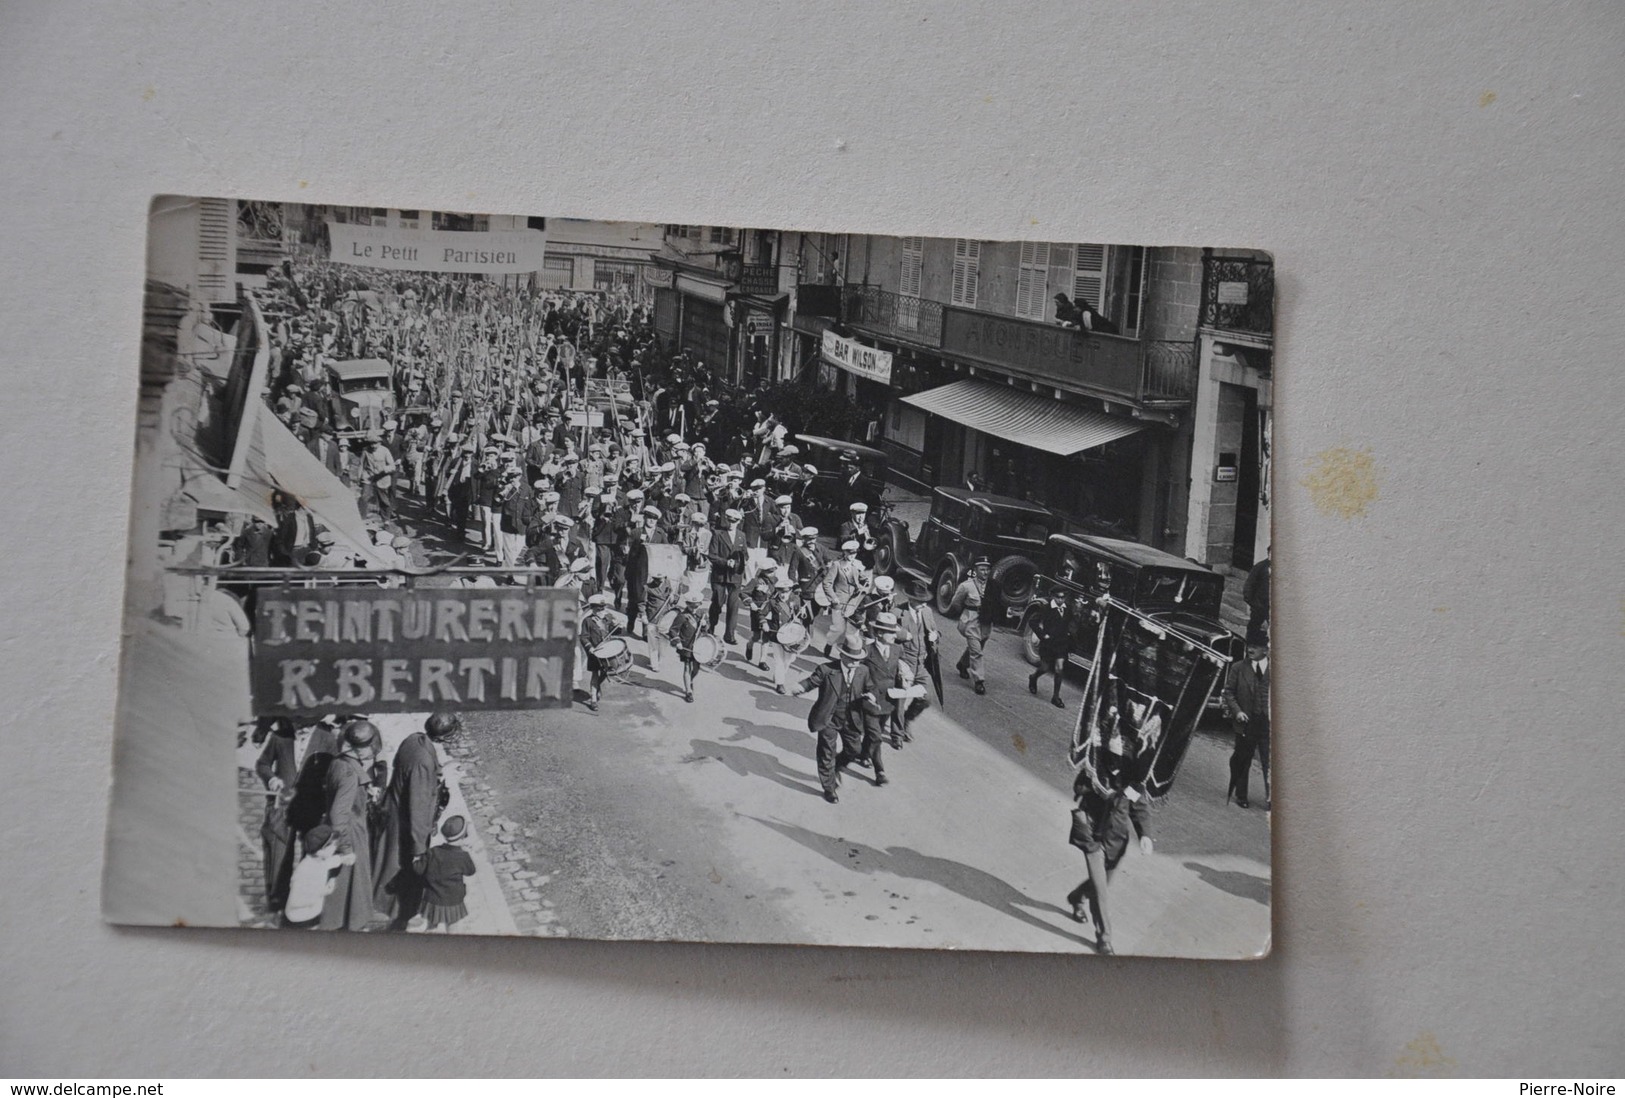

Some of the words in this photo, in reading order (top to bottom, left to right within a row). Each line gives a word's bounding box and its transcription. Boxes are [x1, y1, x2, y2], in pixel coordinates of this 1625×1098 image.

[352, 242, 372, 257] Le
[380, 245, 418, 261] Petit
[443, 248, 516, 264] Parisien
[834, 339, 849, 363] BAR
[852, 347, 877, 373] WILSON
[263, 599, 577, 646] TEINTURERIE
